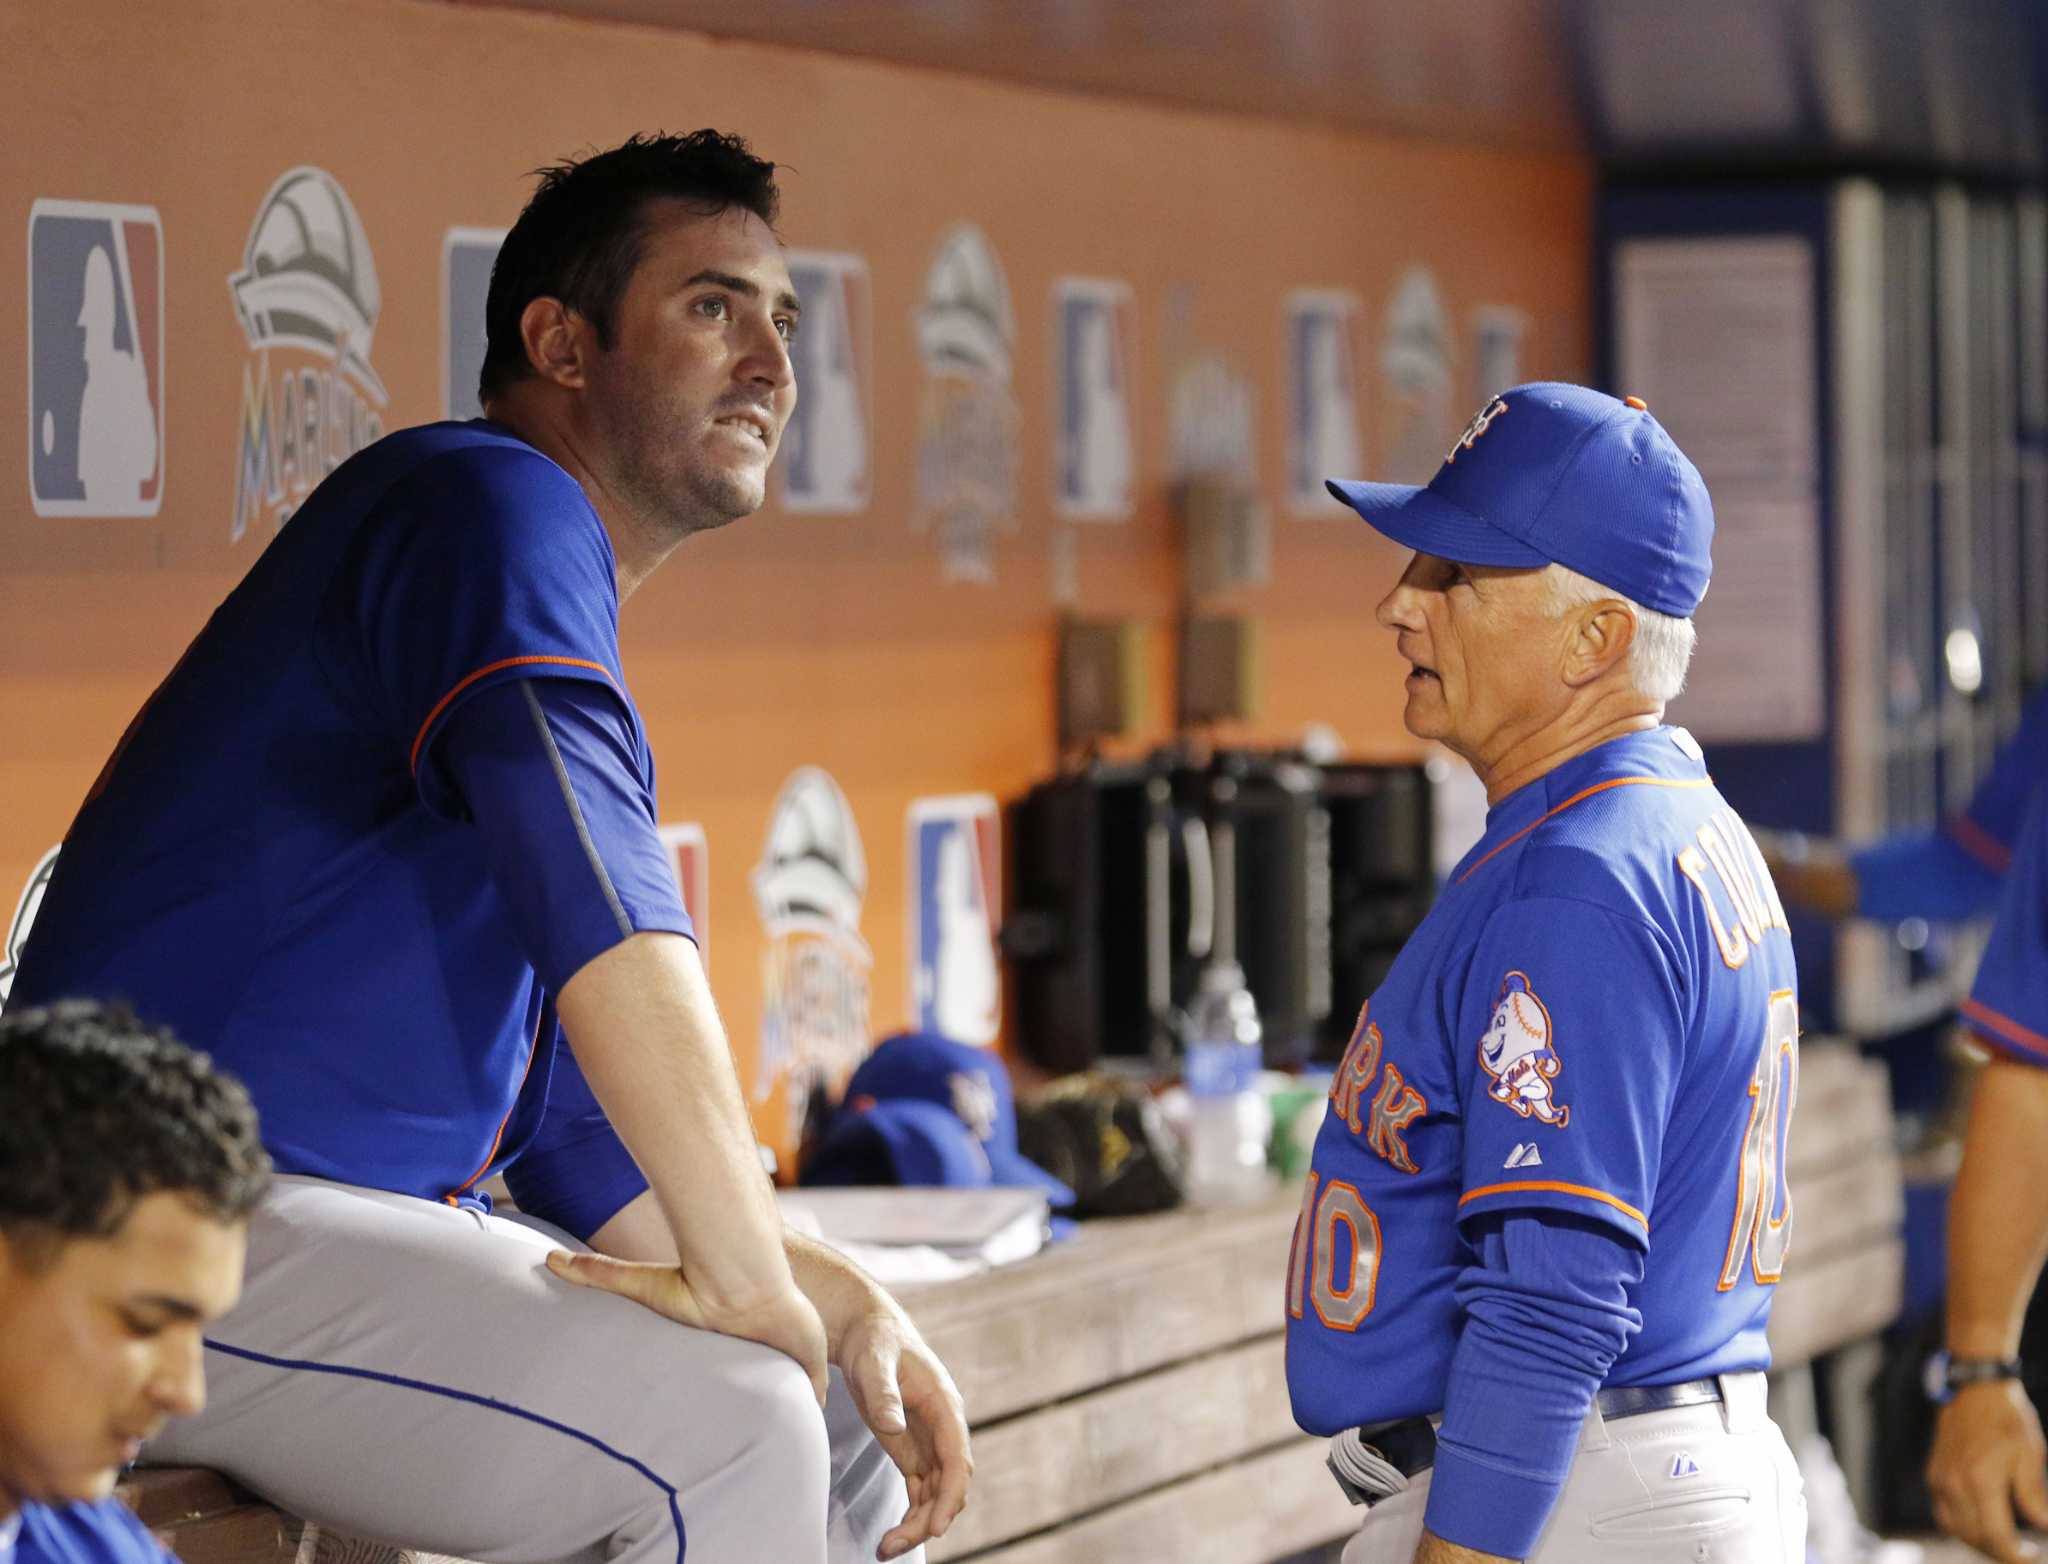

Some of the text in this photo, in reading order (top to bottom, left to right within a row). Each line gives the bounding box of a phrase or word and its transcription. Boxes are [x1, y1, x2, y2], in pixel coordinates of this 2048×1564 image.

[1328, 999, 1427, 1174] RK
[1716, 989, 1800, 1291] 10
[1287, 1170, 1382, 1332] 10
